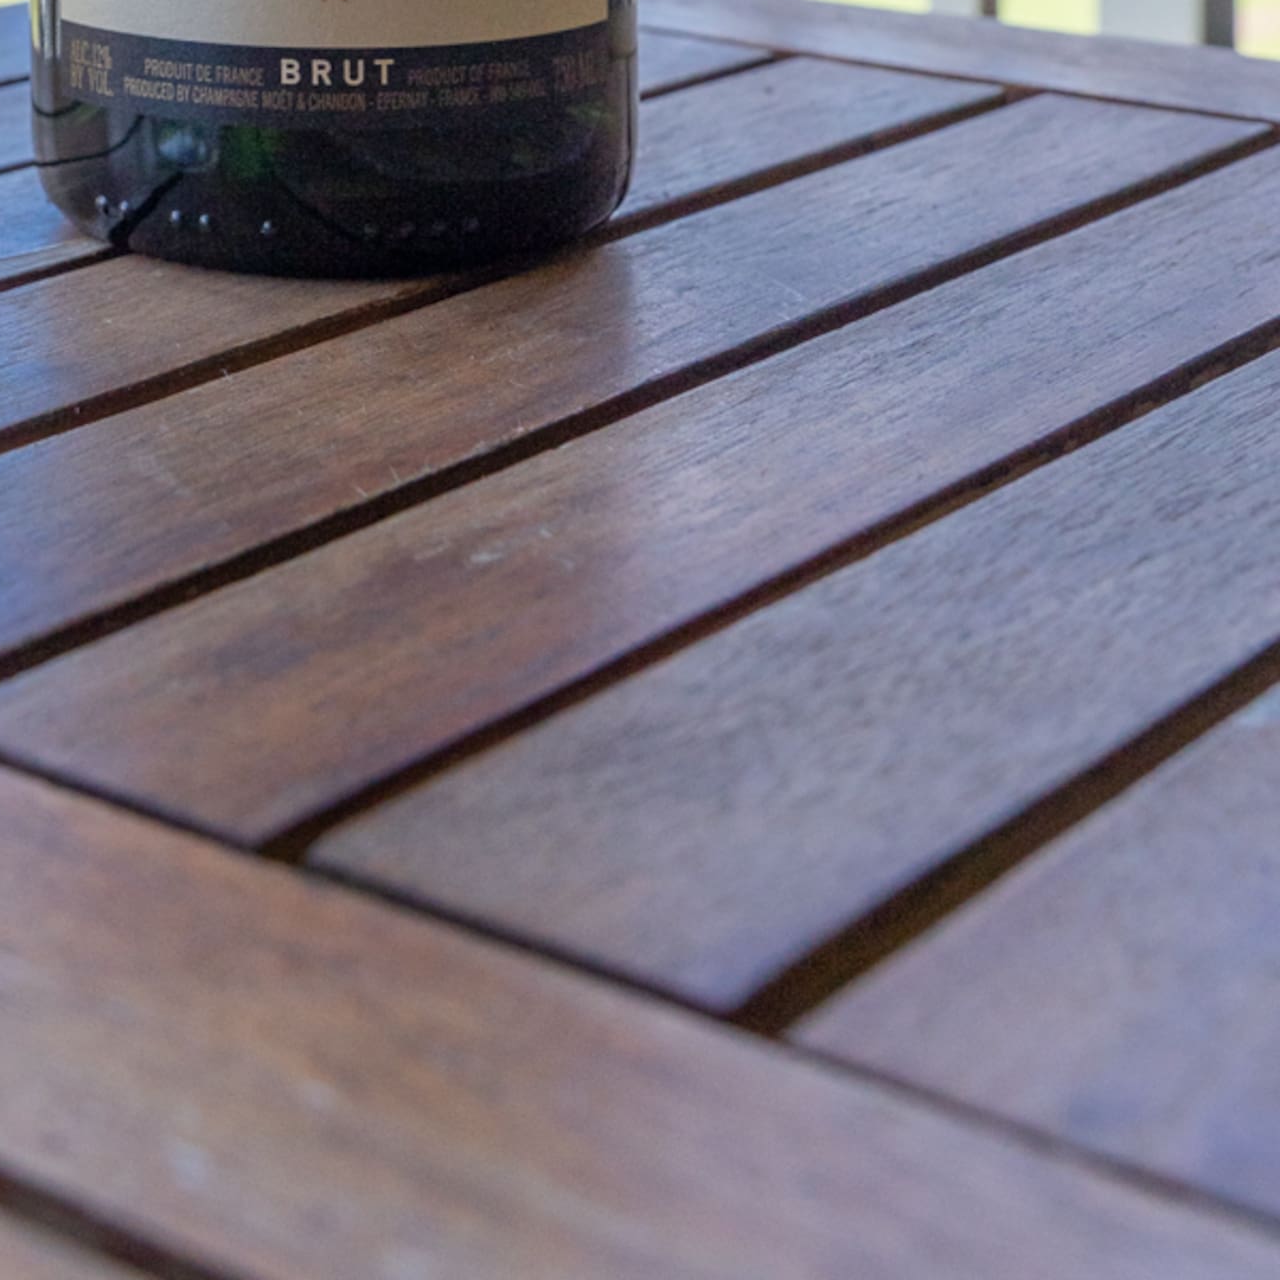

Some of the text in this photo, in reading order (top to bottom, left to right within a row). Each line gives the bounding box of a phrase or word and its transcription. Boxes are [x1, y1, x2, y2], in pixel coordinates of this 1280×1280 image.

[143, 58, 266, 87] PRODUIT DE FRANCE
[280, 58, 396, 86] BRUT
[123, 76, 175, 101] PRODUCED
[176, 83, 191, 102] BY
[192, 85, 259, 109] CHAMPAGNE
